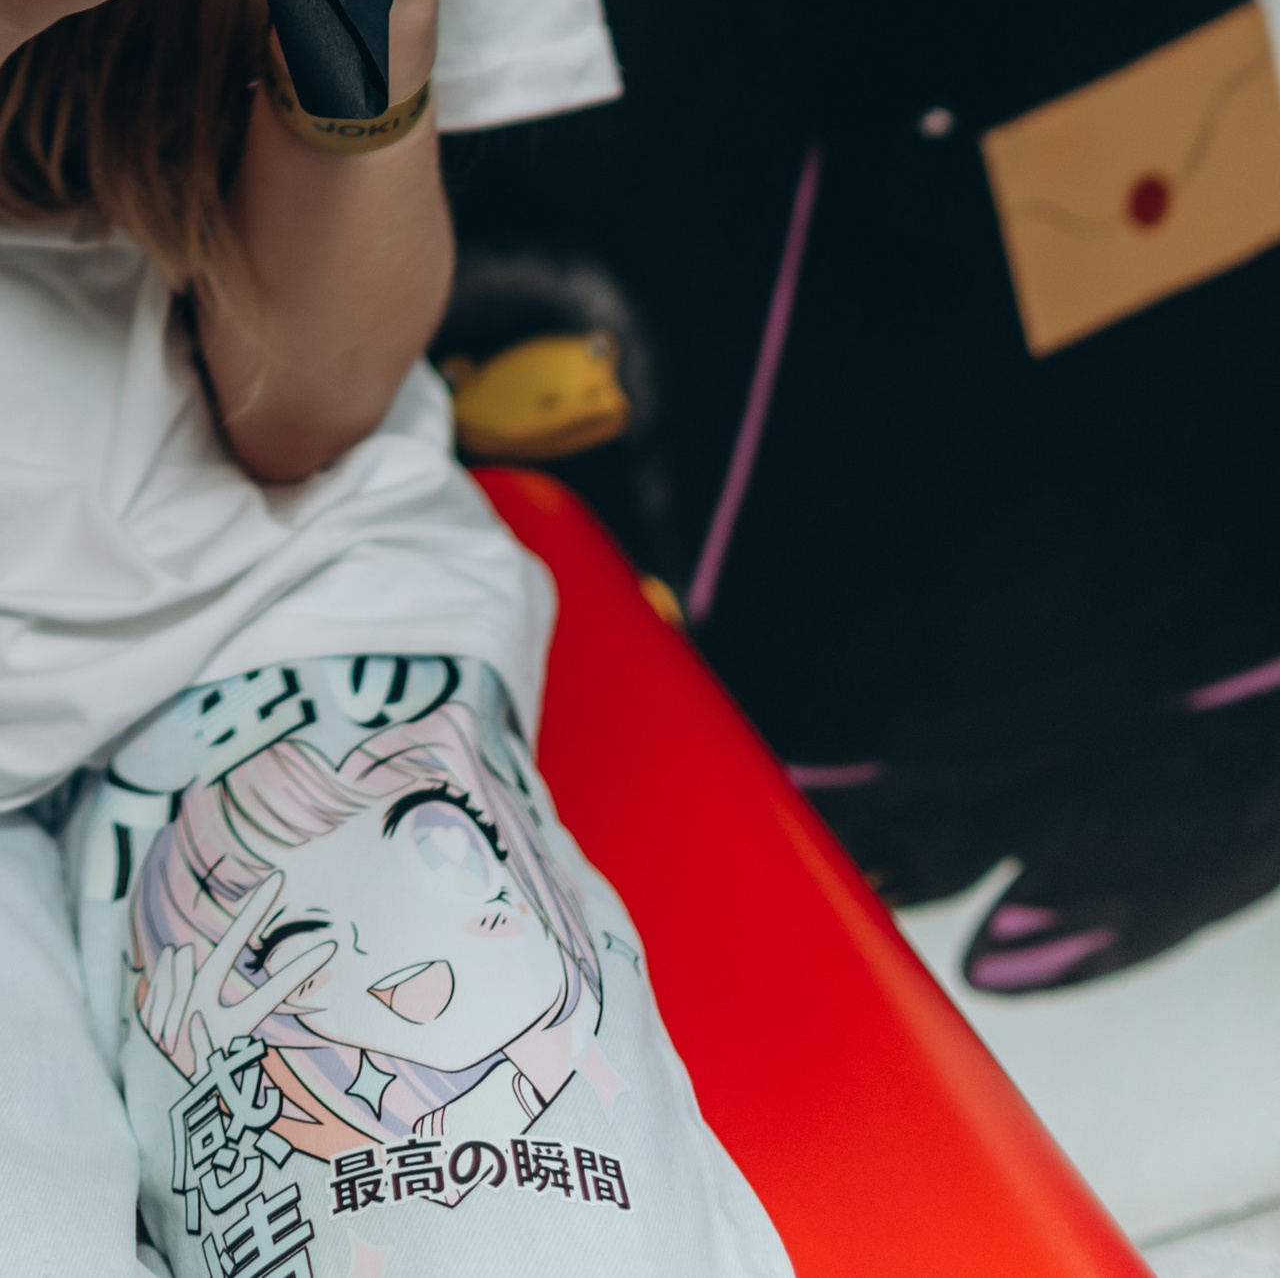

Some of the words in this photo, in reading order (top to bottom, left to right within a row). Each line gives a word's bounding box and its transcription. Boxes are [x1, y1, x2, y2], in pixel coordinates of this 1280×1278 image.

[330, 1139, 631, 1211] 最高の瞬間
